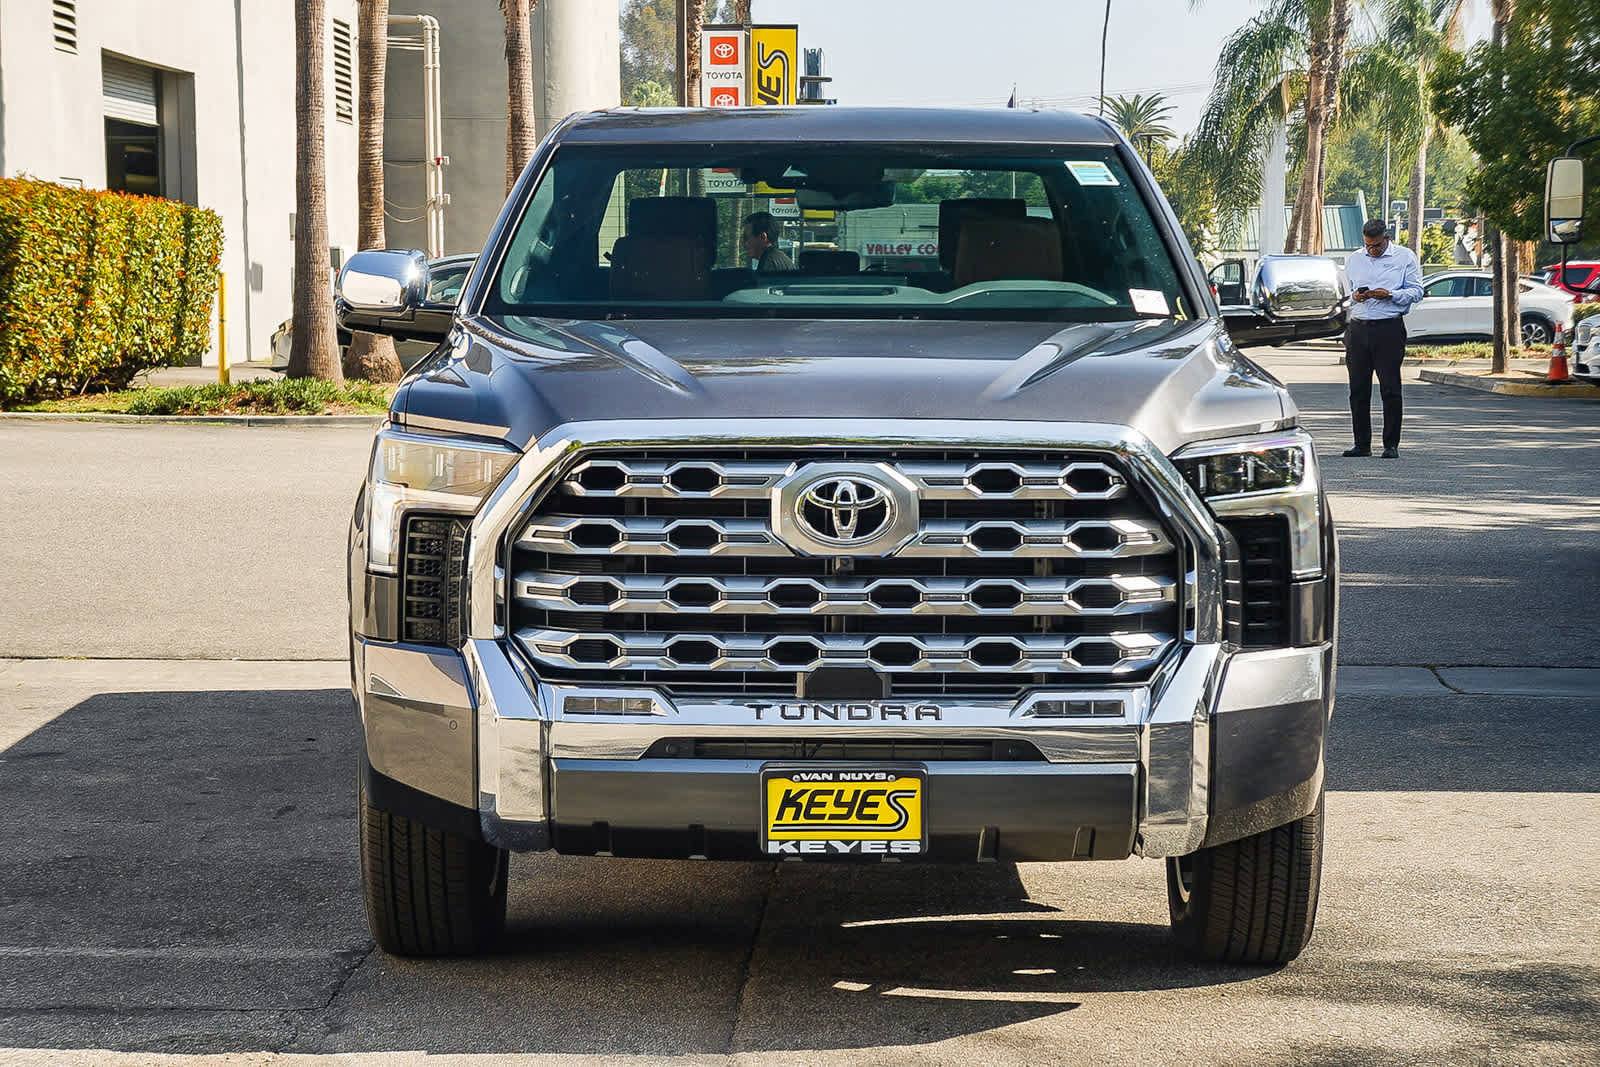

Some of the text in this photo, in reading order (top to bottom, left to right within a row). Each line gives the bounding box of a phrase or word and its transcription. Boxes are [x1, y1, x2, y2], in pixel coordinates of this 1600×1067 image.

[705, 71, 743, 80] TOYOTA
[707, 179, 744, 187] TOYOTA
[866, 243, 941, 255] VALLEY CO
[746, 703, 942, 721] TUNDRA
[799, 772, 887, 781] VAN NUYS
[770, 789, 918, 832] KEYES
[767, 840, 921, 853] KEYES
